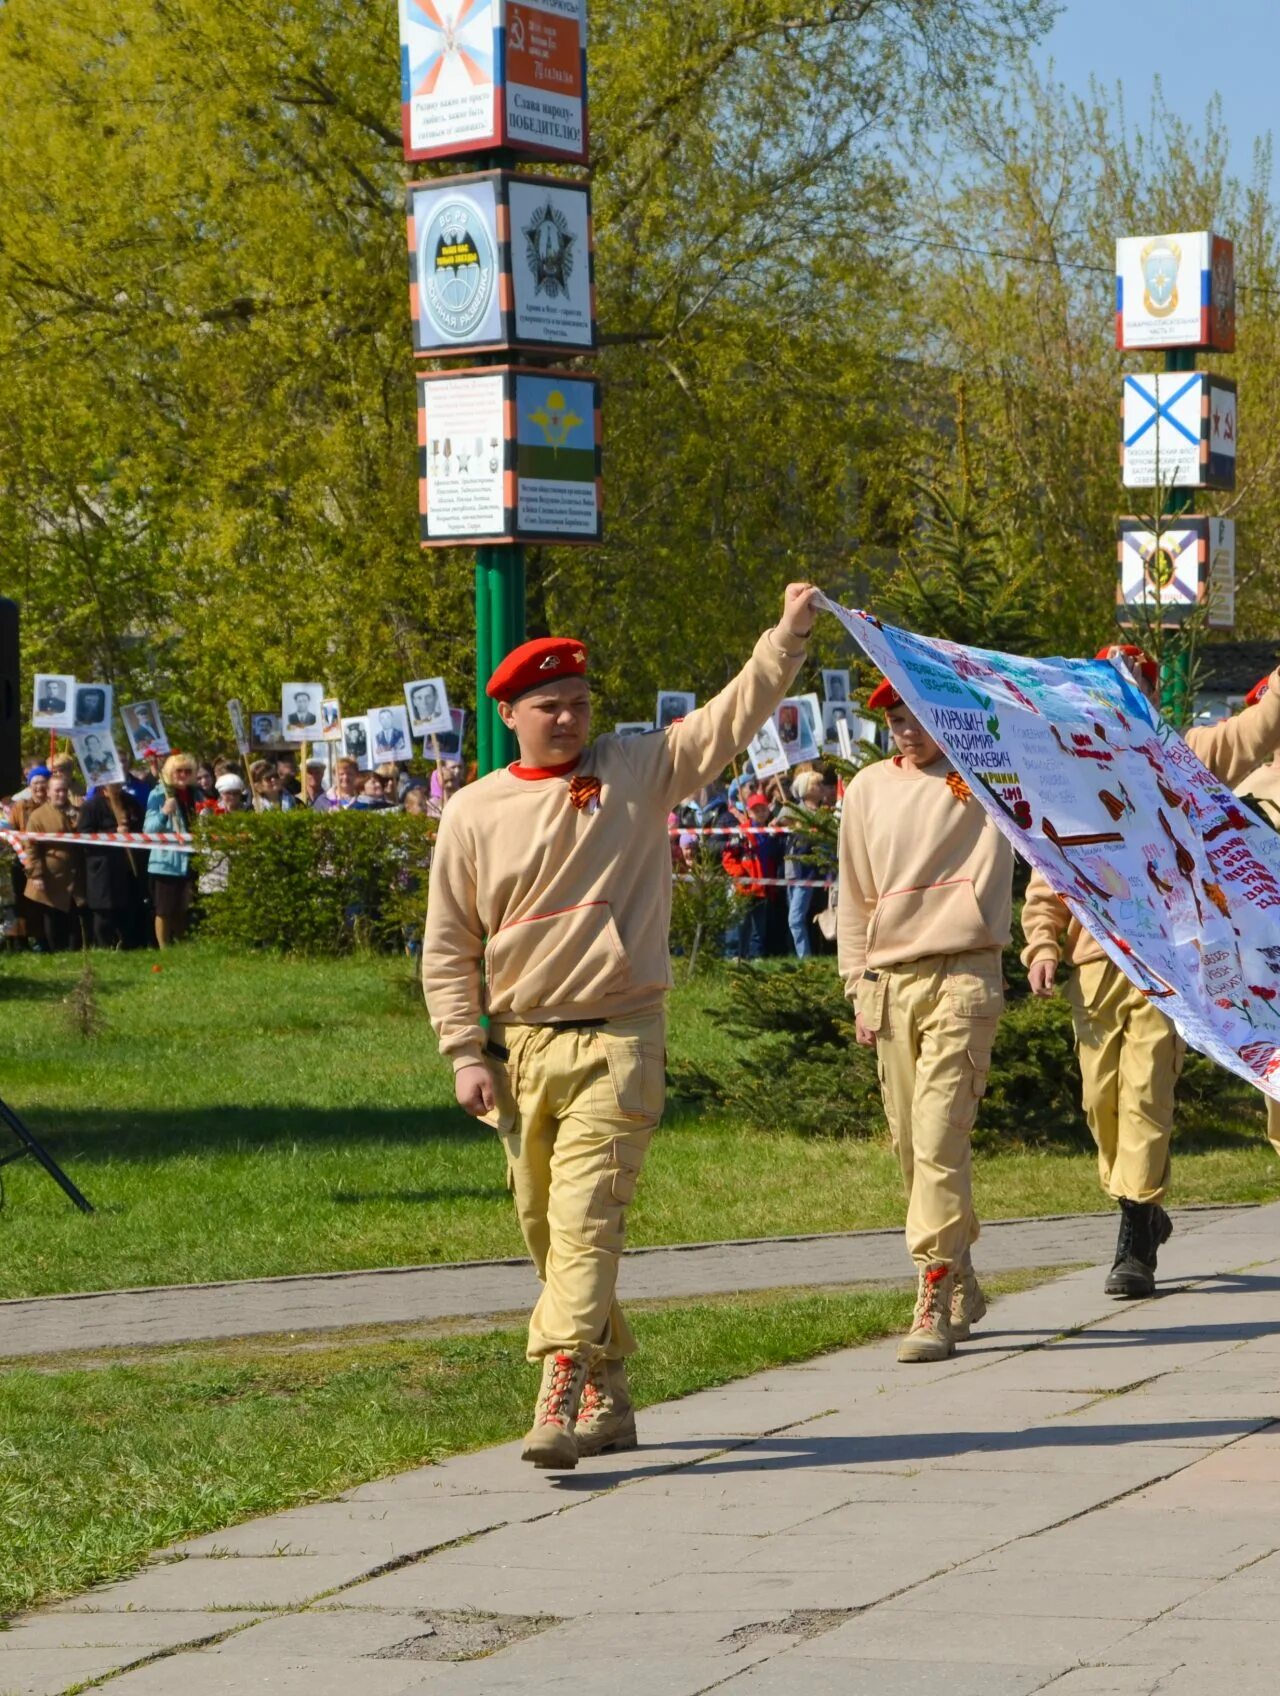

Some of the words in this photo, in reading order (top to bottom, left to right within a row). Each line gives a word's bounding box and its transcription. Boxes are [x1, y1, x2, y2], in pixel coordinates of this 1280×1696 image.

[514, 93, 540, 112] Слава
[509, 112, 580, 142] ПОБЕДИТЕЛЮ!
[957, 751, 1011, 768] ИКОЛАЕВИЧ
